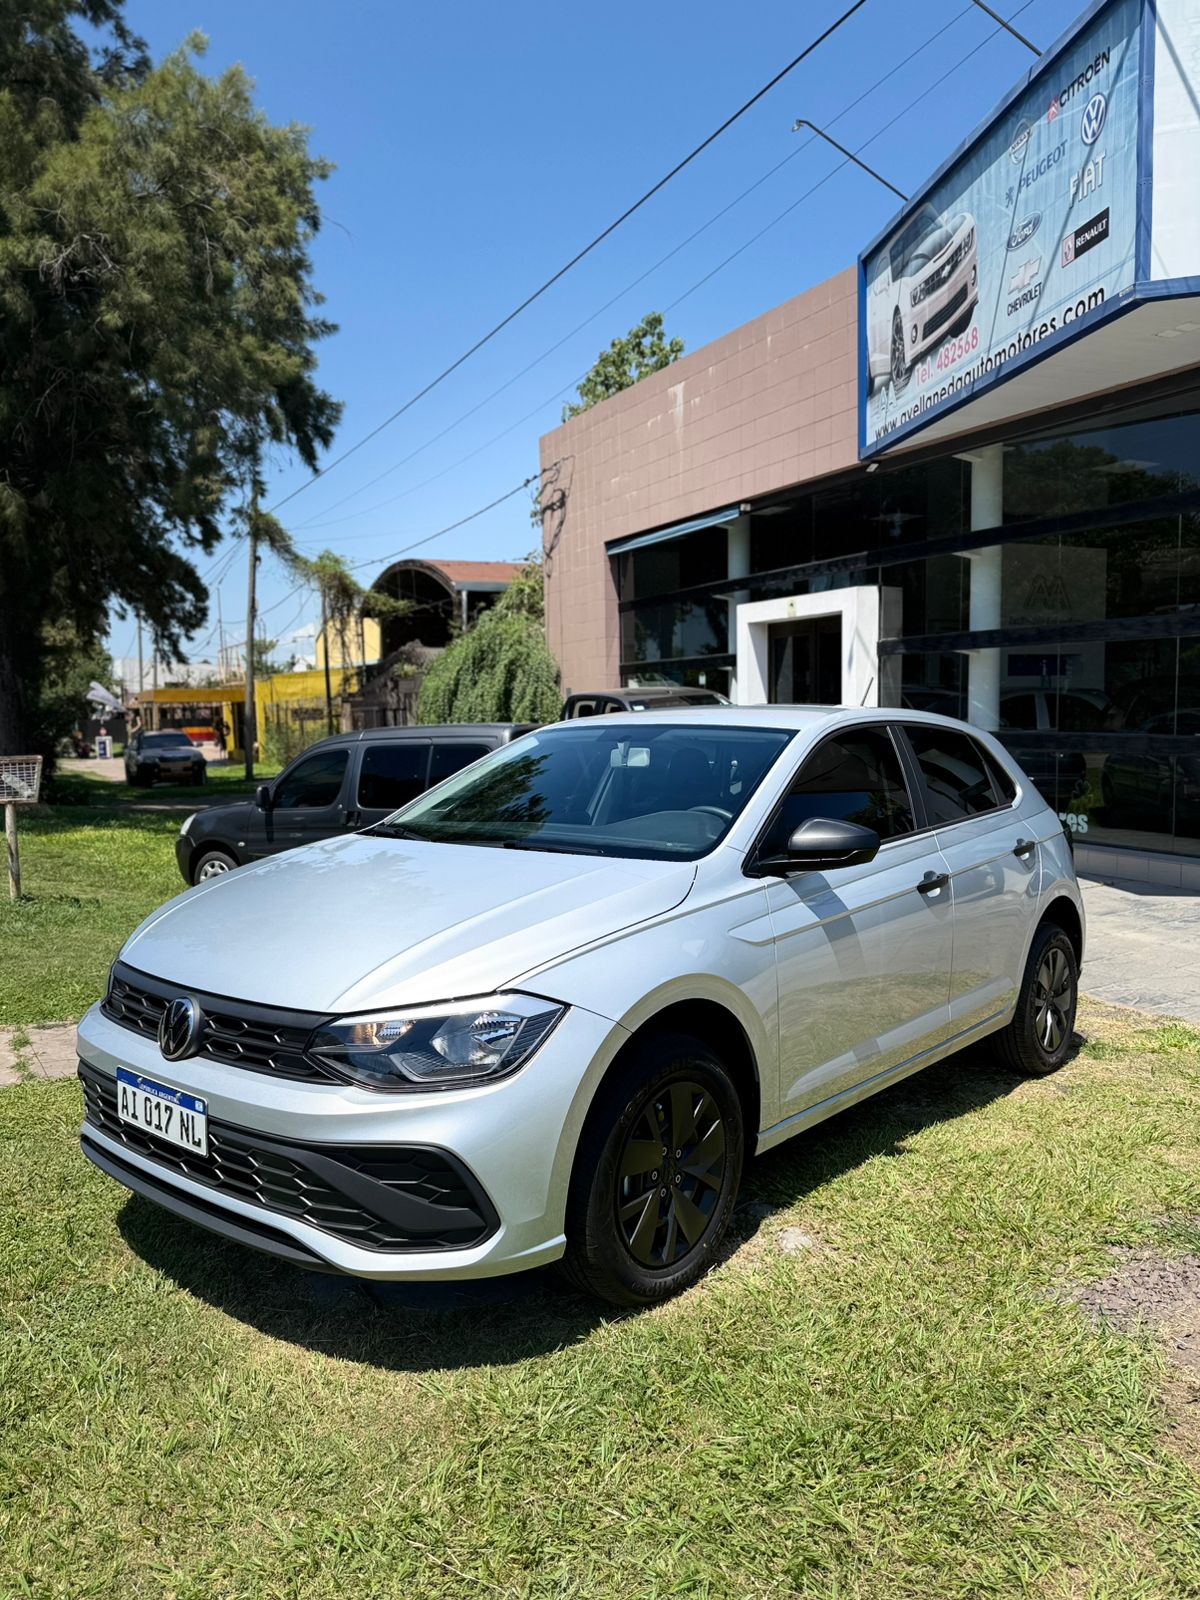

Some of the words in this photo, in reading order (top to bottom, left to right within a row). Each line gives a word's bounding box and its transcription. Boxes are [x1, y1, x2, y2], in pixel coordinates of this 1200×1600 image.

[1059, 46, 1111, 108] CITROËN
[1019, 139, 1068, 192] PEUGEOT
[1069, 149, 1106, 209] FIAT
[1075, 218, 1108, 248] RENAULT
[1006, 282, 1042, 317] CHEVROLET
[936, 326, 979, 371] 482568
[121, 1086, 138, 1120] AI
[144, 1096, 173, 1135] 017
[179, 1110, 202, 1147] NL
